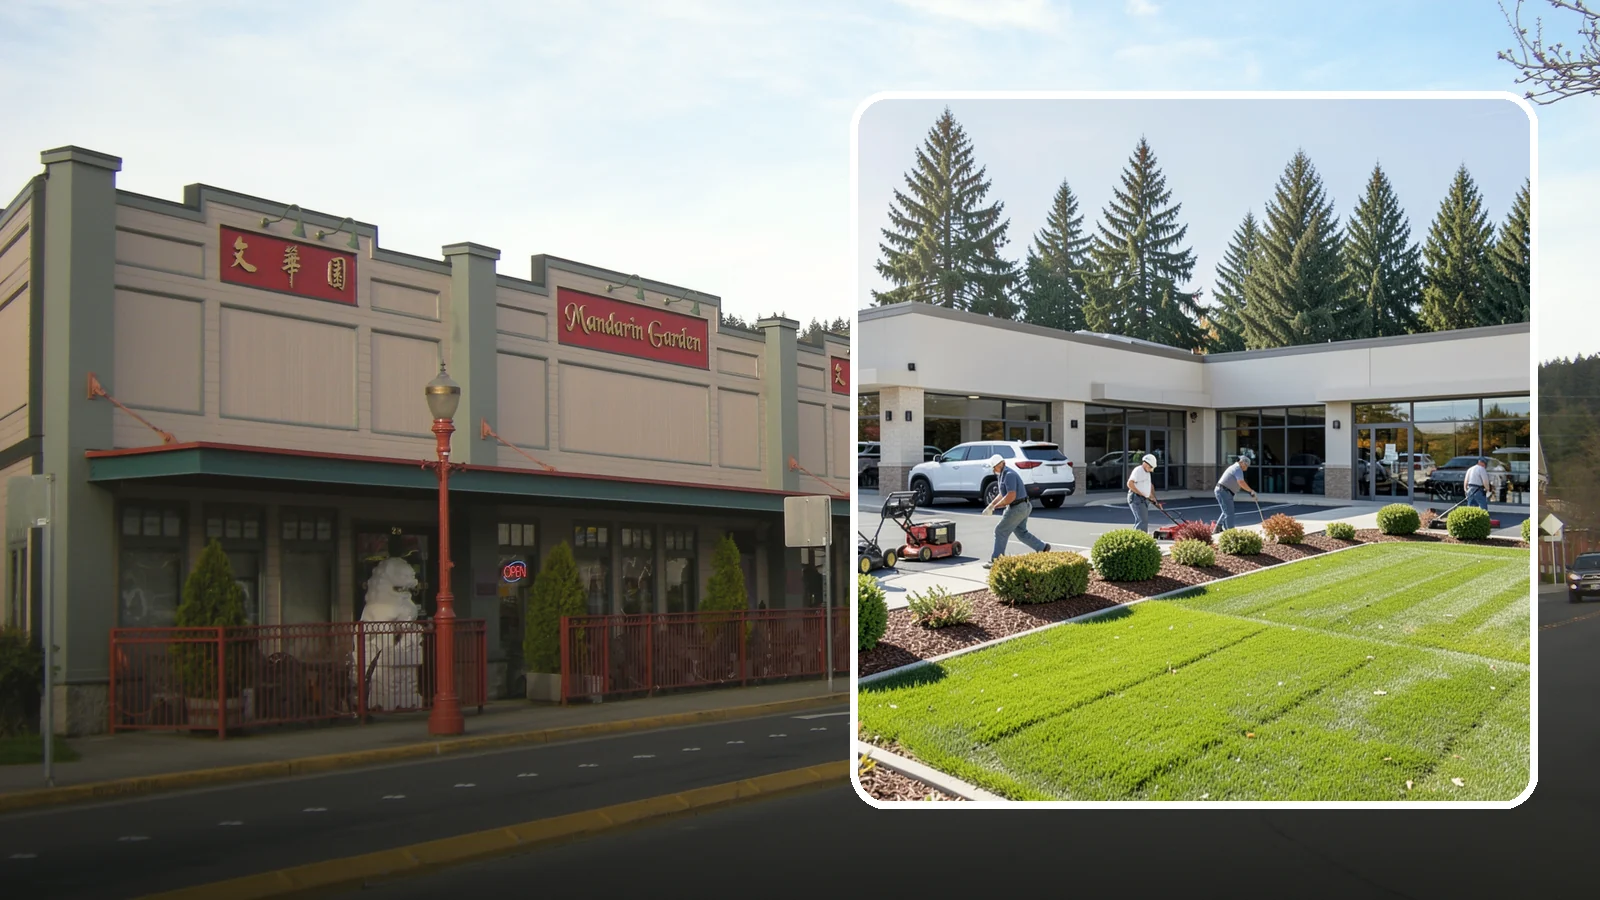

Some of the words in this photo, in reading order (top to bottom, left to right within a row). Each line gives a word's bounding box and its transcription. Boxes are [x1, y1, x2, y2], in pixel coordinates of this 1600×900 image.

[230, 235, 346, 291] 文華園
[564, 302, 644, 341] Mandarin
[648, 320, 701, 352] Garden
[835, 363, 846, 386] 文
[503, 565, 527, 578] OPEN
